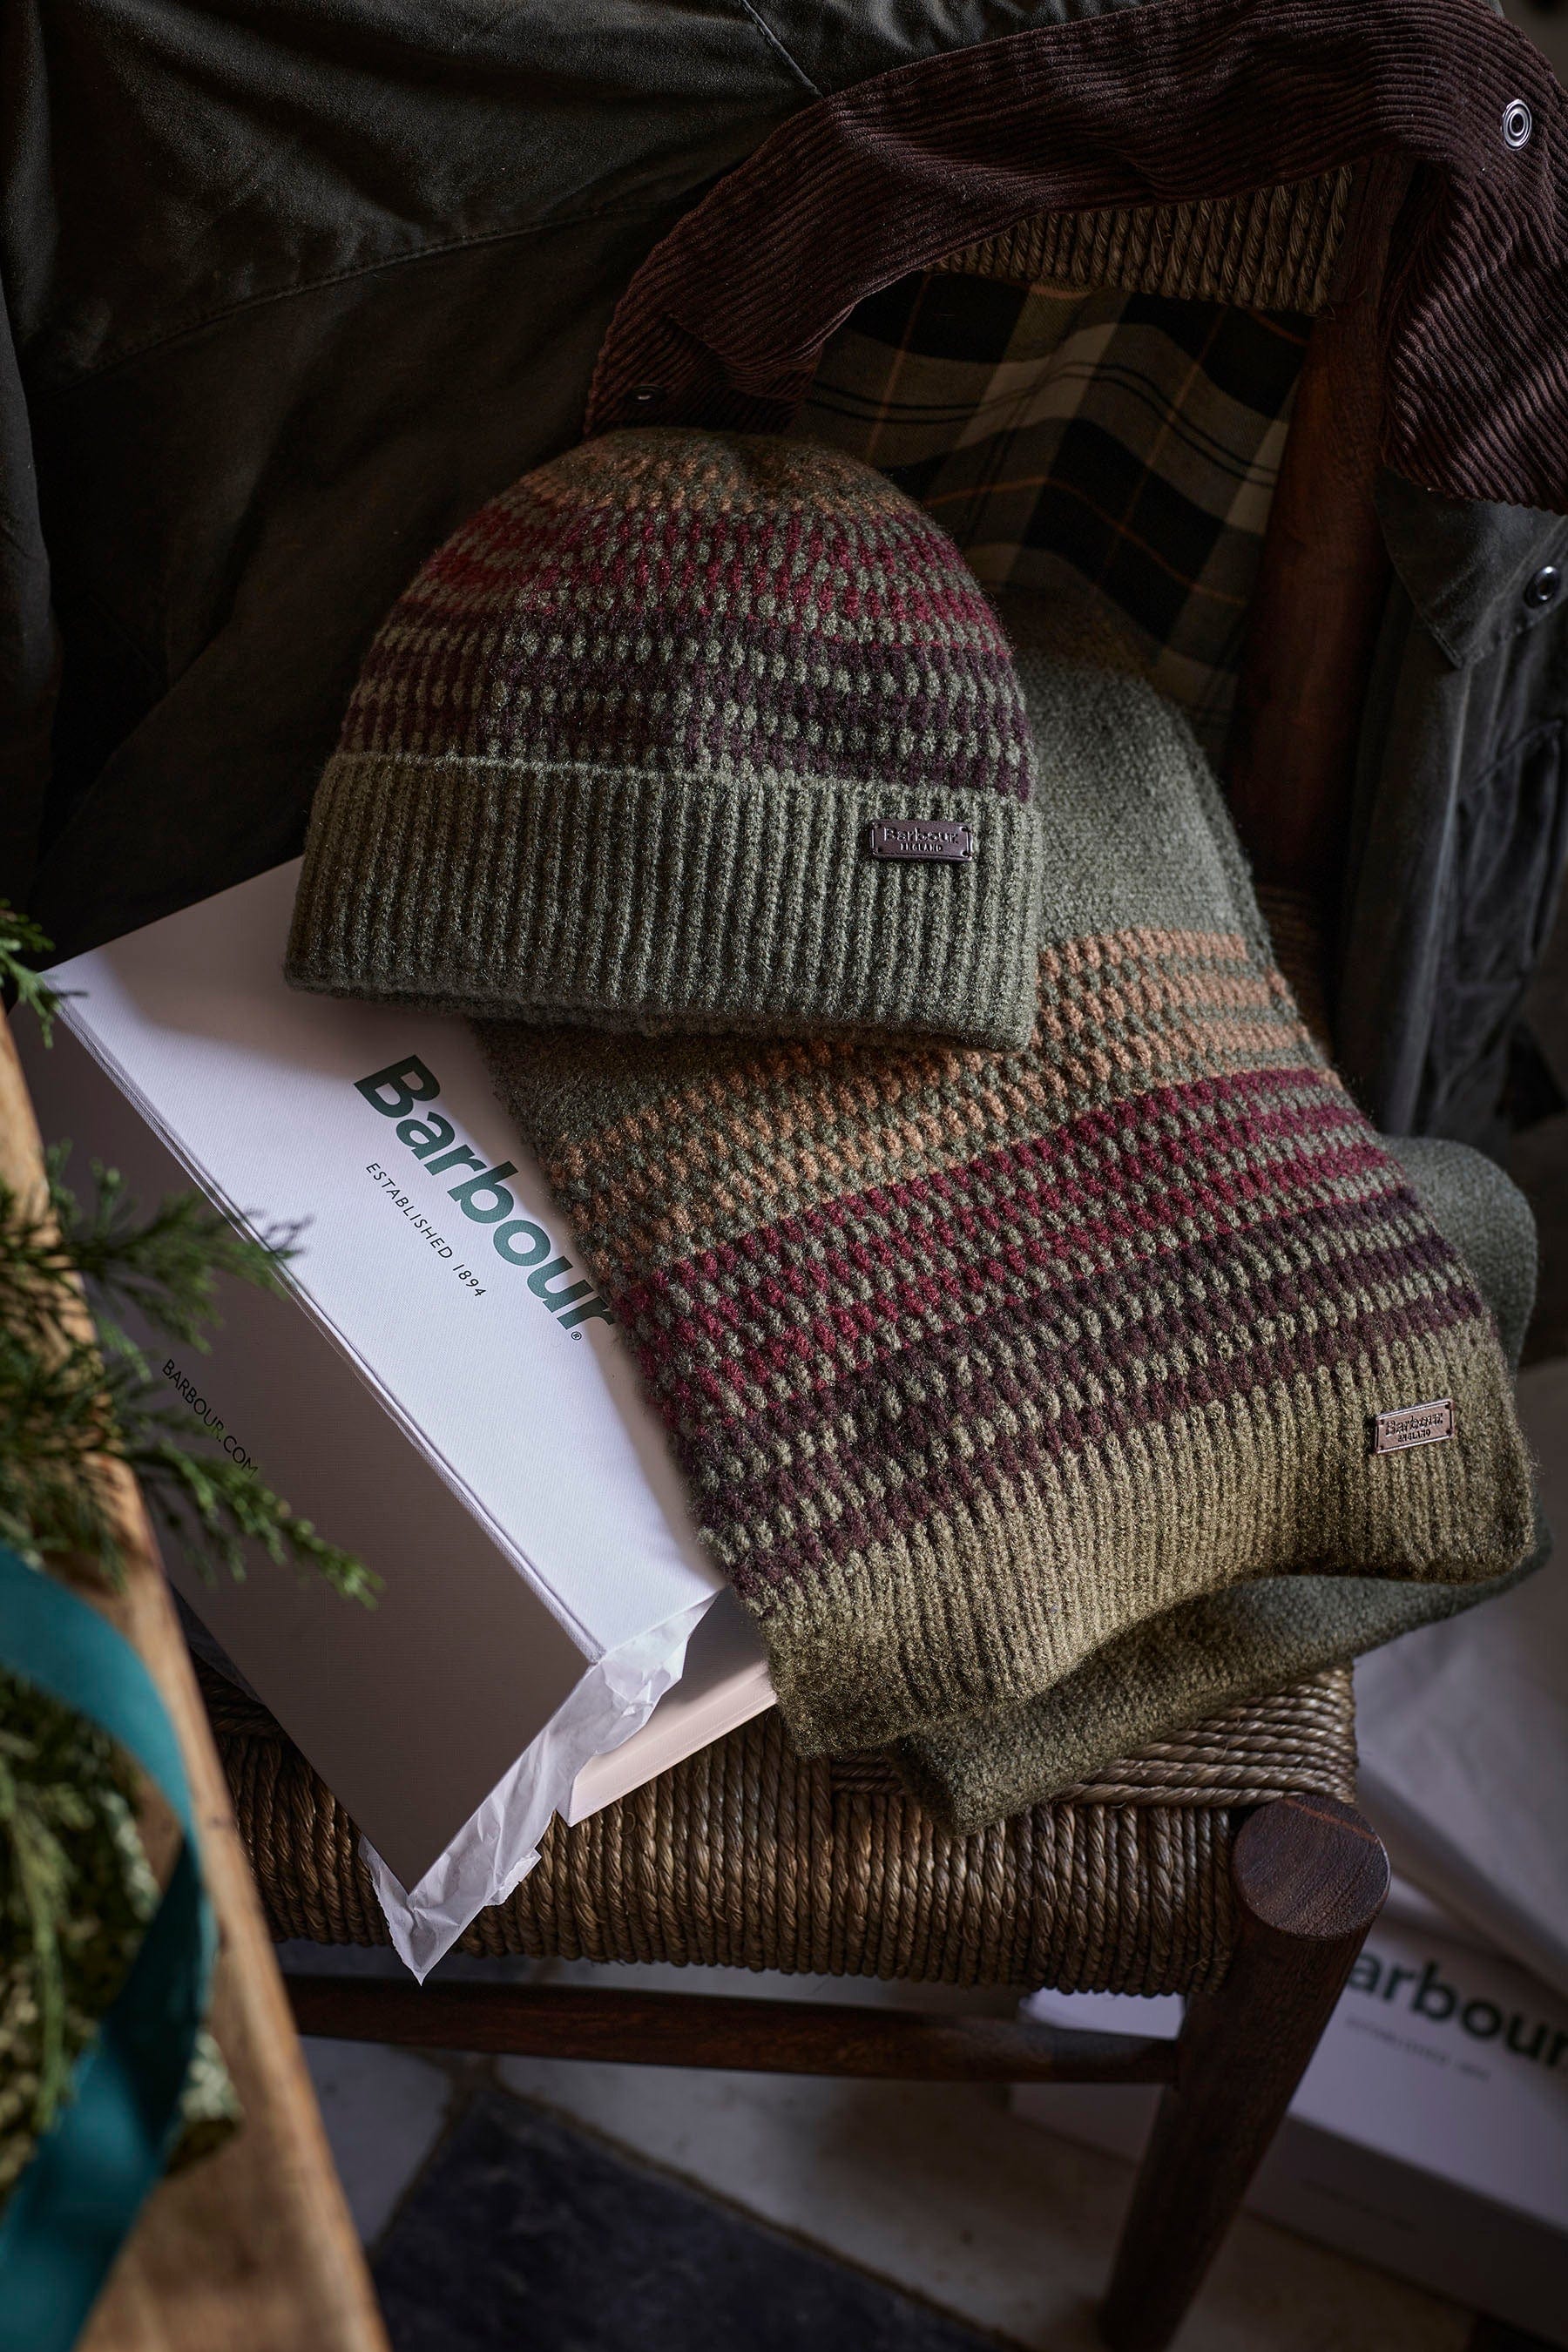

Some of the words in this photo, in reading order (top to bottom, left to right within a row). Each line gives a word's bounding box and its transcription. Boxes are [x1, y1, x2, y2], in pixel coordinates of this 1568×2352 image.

[900, 843, 943, 852] ENGLAND
[365, 1162, 453, 1260] ESTABLISHED
[452, 1263, 487, 1297] 1894
[162, 1358, 259, 1478] BARBOUR.COM
[1347, 1952, 1568, 2068] arbour
